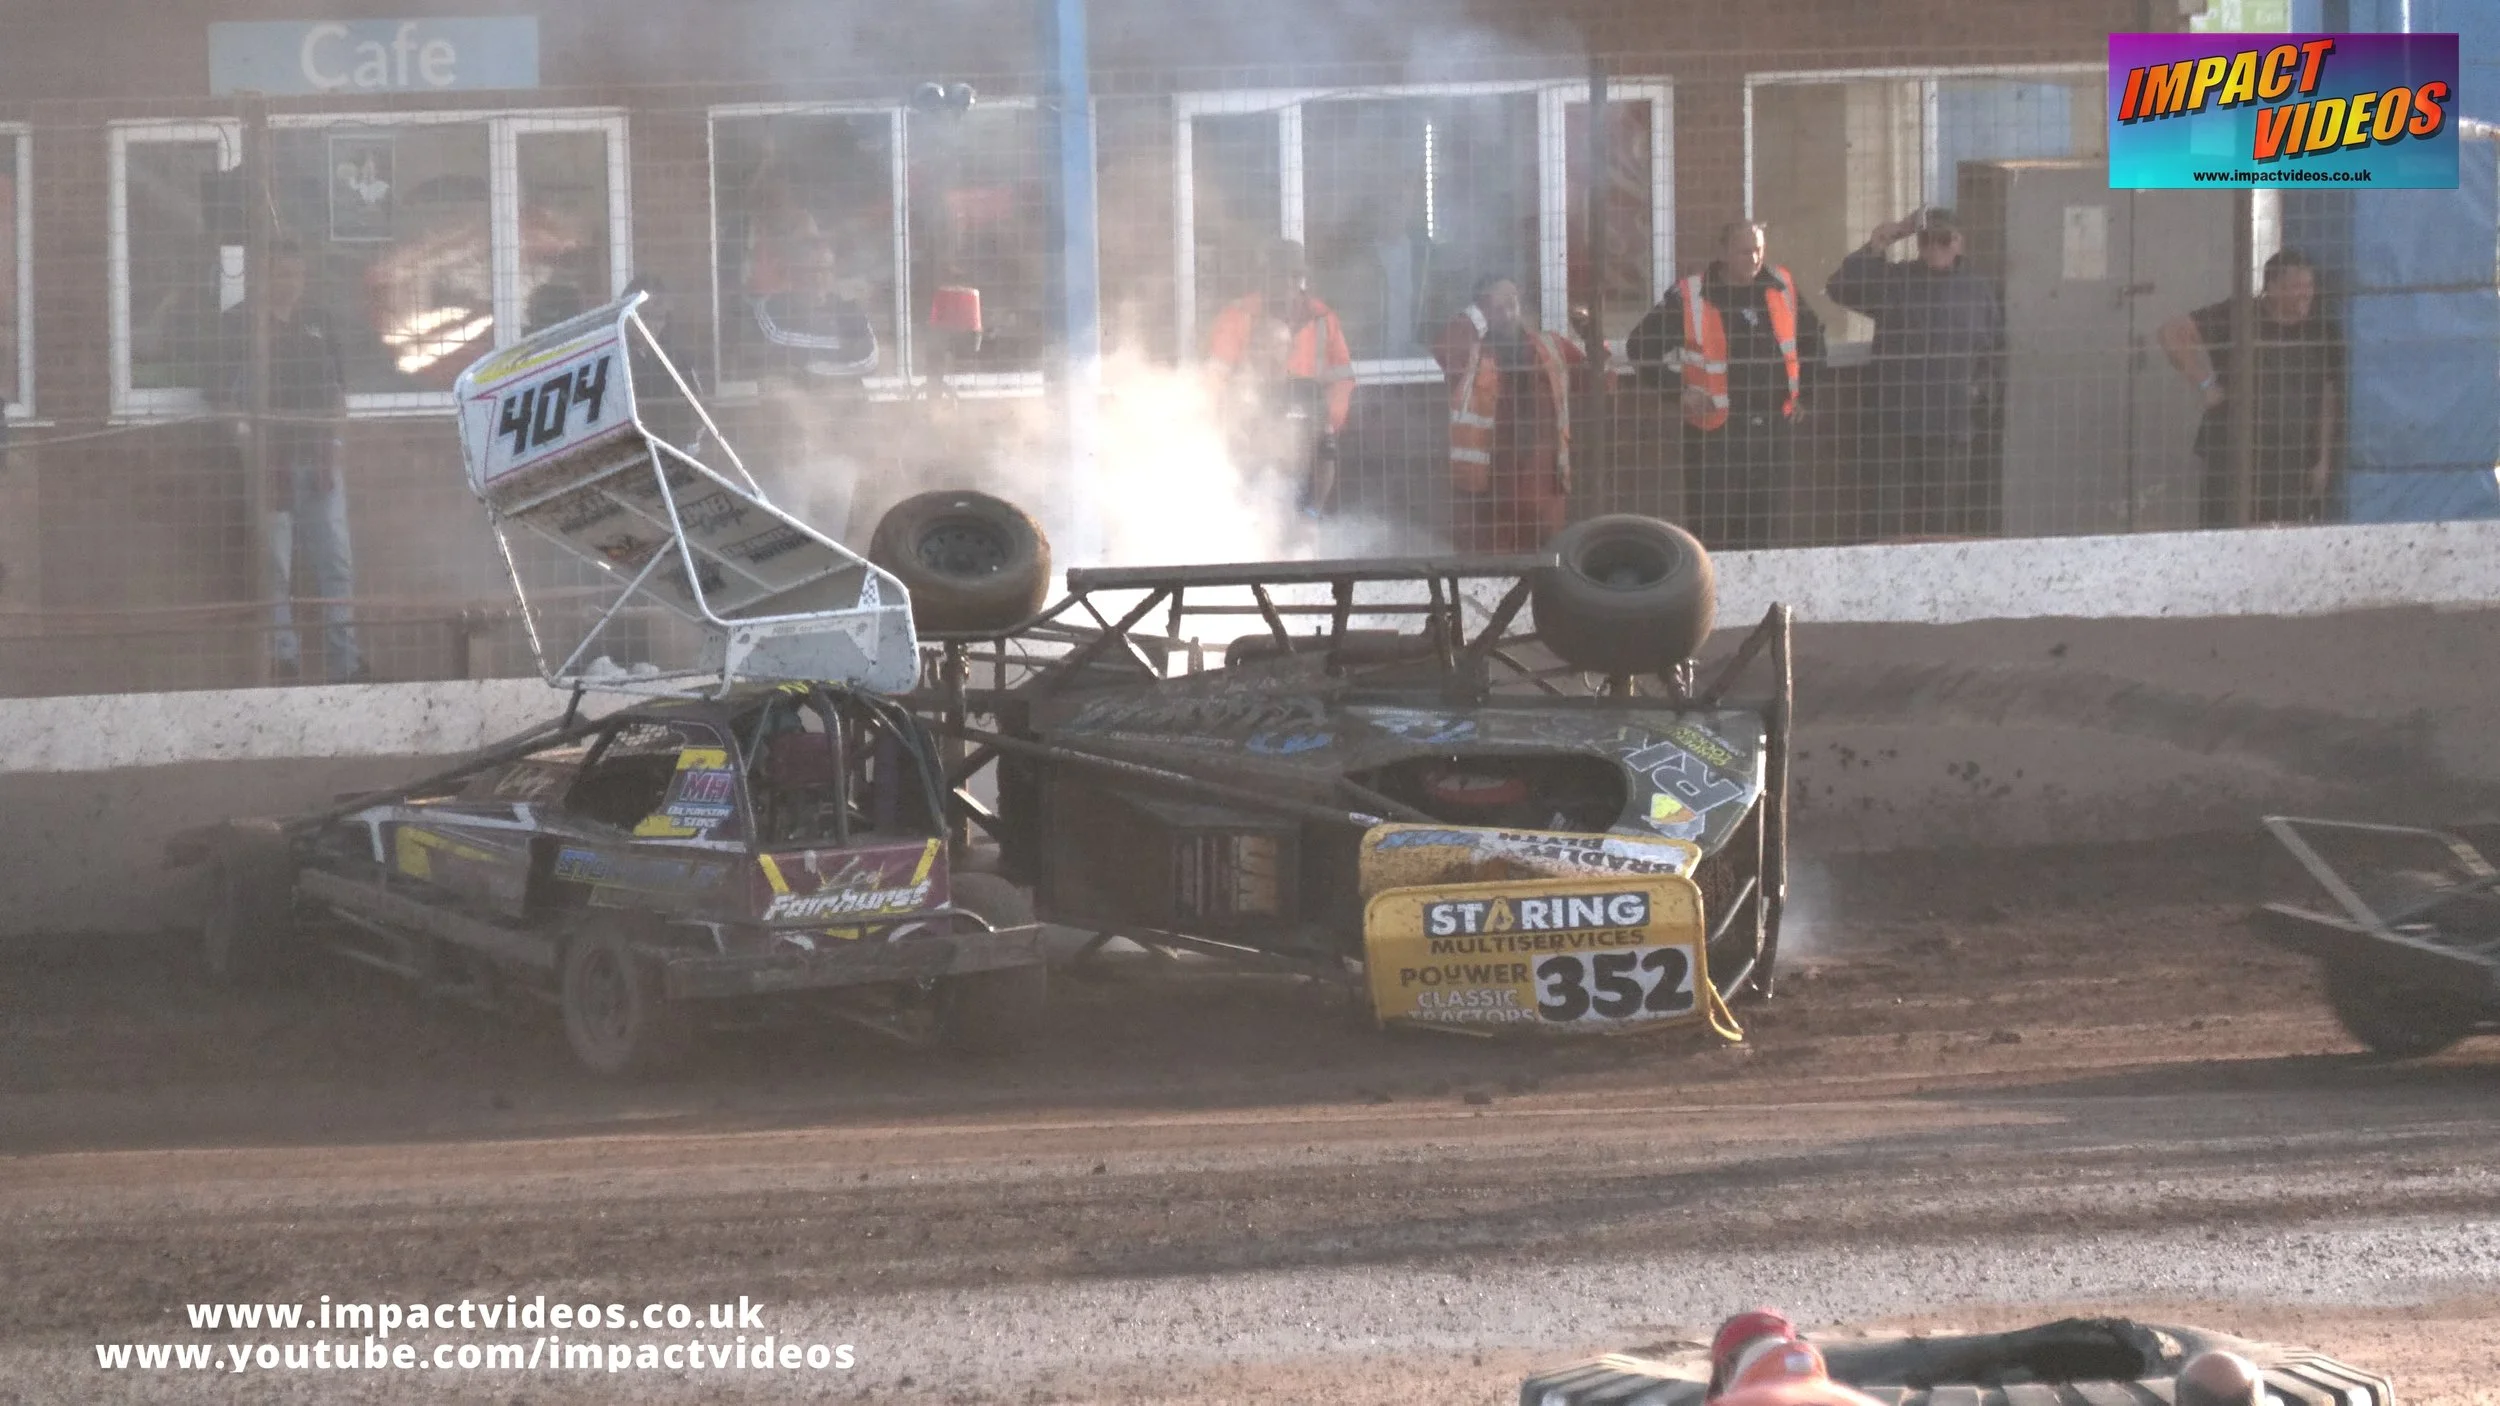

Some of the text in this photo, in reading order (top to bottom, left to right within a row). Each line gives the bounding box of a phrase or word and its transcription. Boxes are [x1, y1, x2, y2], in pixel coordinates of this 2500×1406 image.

[301, 24, 457, 89] Cafe
[498, 354, 612, 455] 404
[762, 879, 933, 921] Fairhurst
[1430, 894, 1647, 936] STARING
[1429, 928, 1646, 955] MULTISERVICES
[1416, 988, 1519, 1009] CLASSIC
[1535, 947, 1694, 1023] 352
